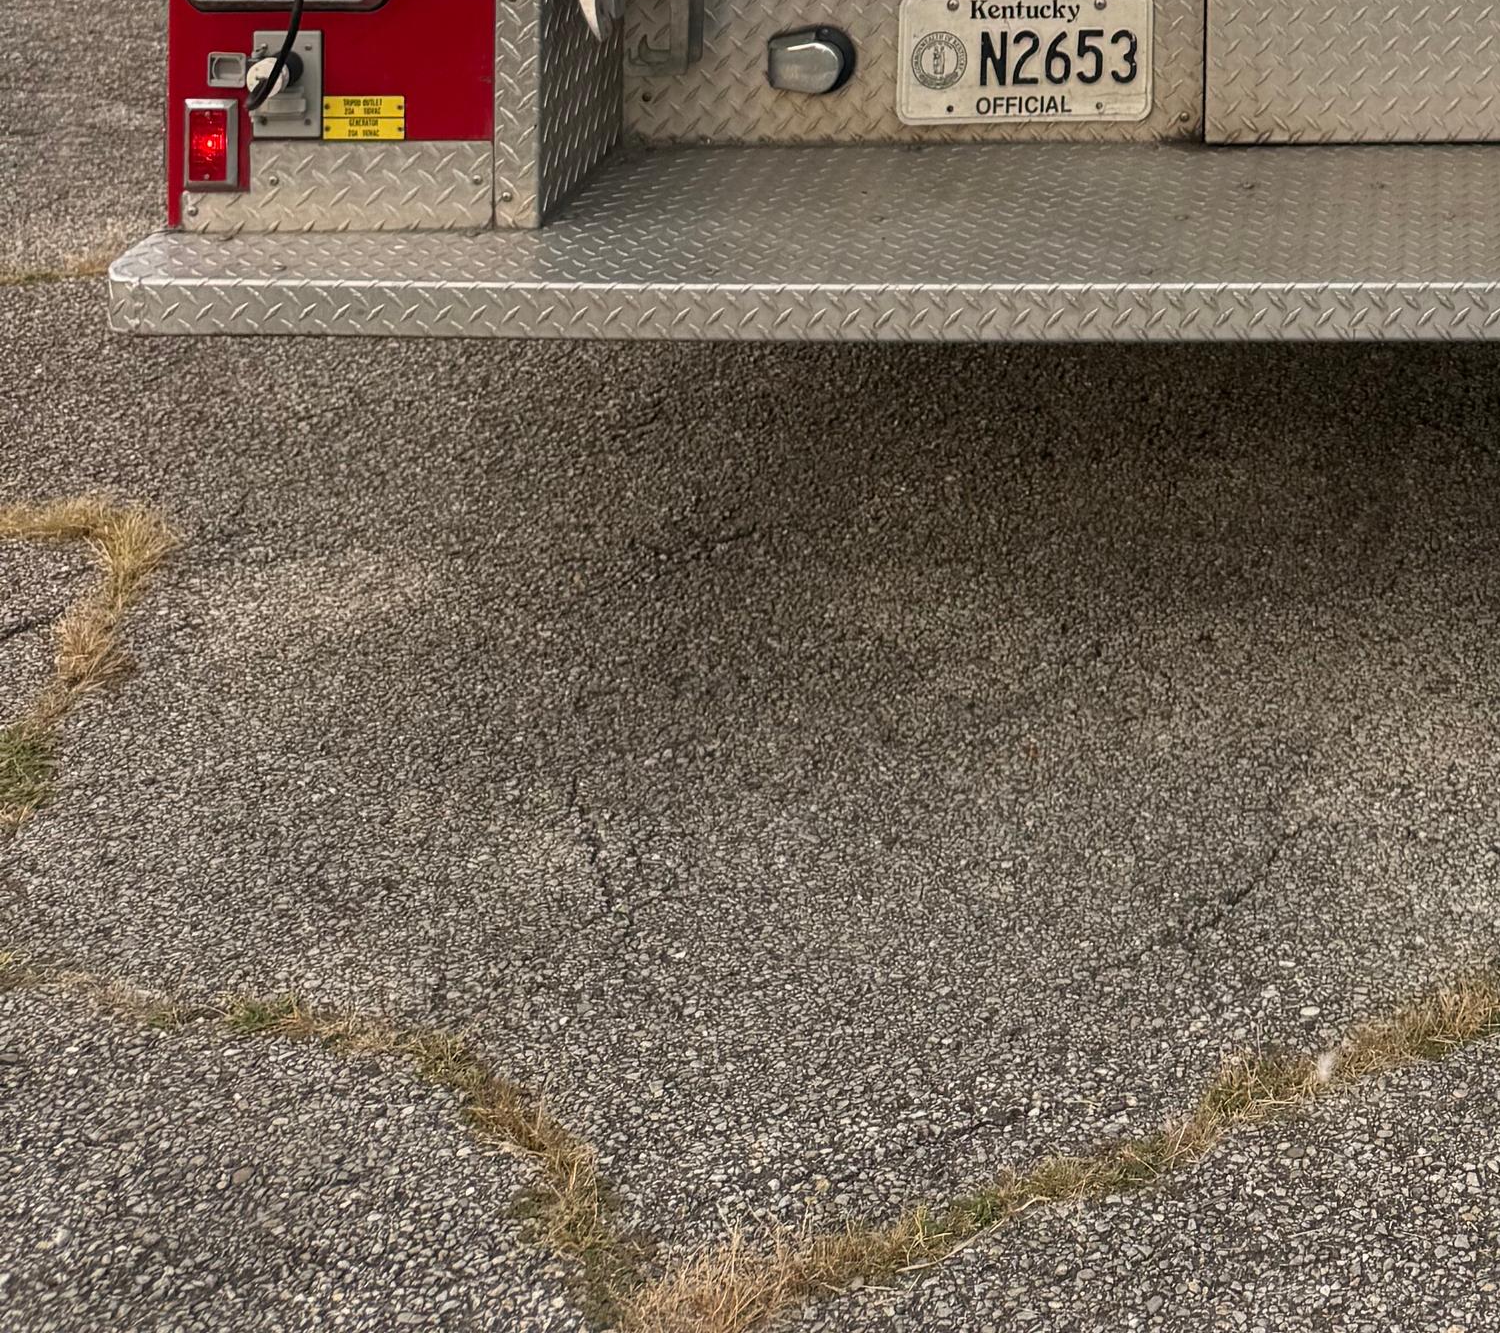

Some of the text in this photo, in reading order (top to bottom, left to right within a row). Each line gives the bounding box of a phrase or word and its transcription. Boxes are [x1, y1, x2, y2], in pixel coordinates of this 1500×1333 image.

[970, 0, 1081, 23] Kentucky
[979, 29, 1138, 87] N2653
[975, 95, 1073, 115] OFFICIAL
